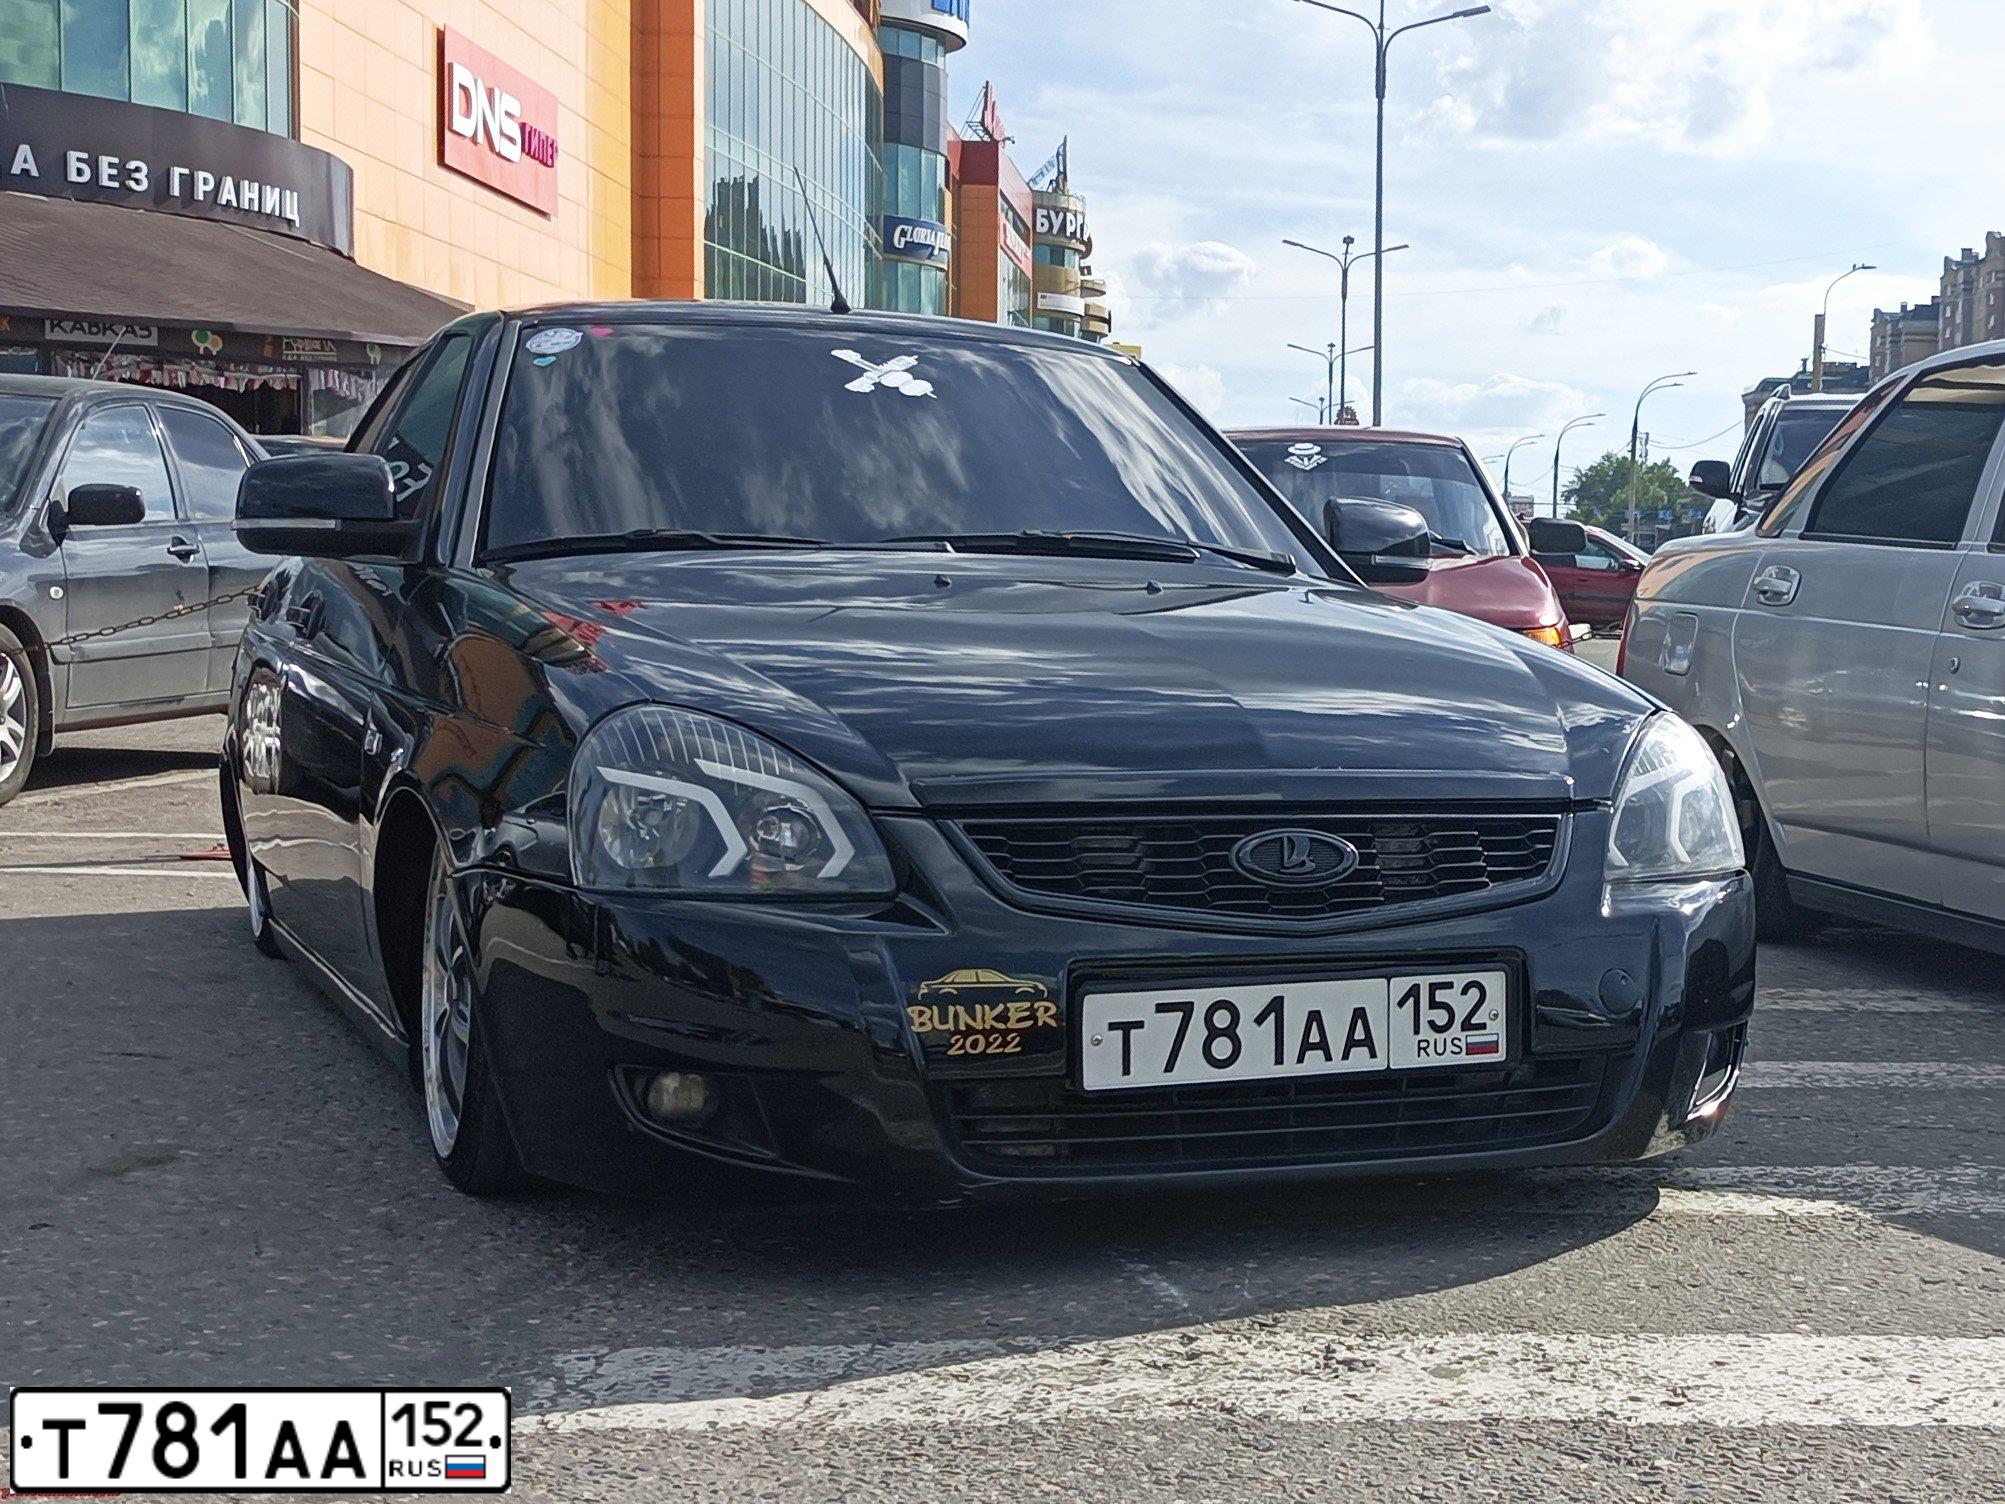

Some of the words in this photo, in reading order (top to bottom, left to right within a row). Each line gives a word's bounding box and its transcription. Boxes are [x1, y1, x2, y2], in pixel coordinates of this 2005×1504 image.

[449, 61, 522, 164] DNS
[66, 150, 149, 192] БЕЗ
[169, 166, 300, 228] ГРАНИЦ
[906, 1001, 1058, 1033] BUNKER
[947, 1032, 1022, 1056] 2022
[1107, 995, 1379, 1077] Т781АА
[1396, 980, 1488, 1036] 152
[1417, 1037, 1463, 1059] RUS
